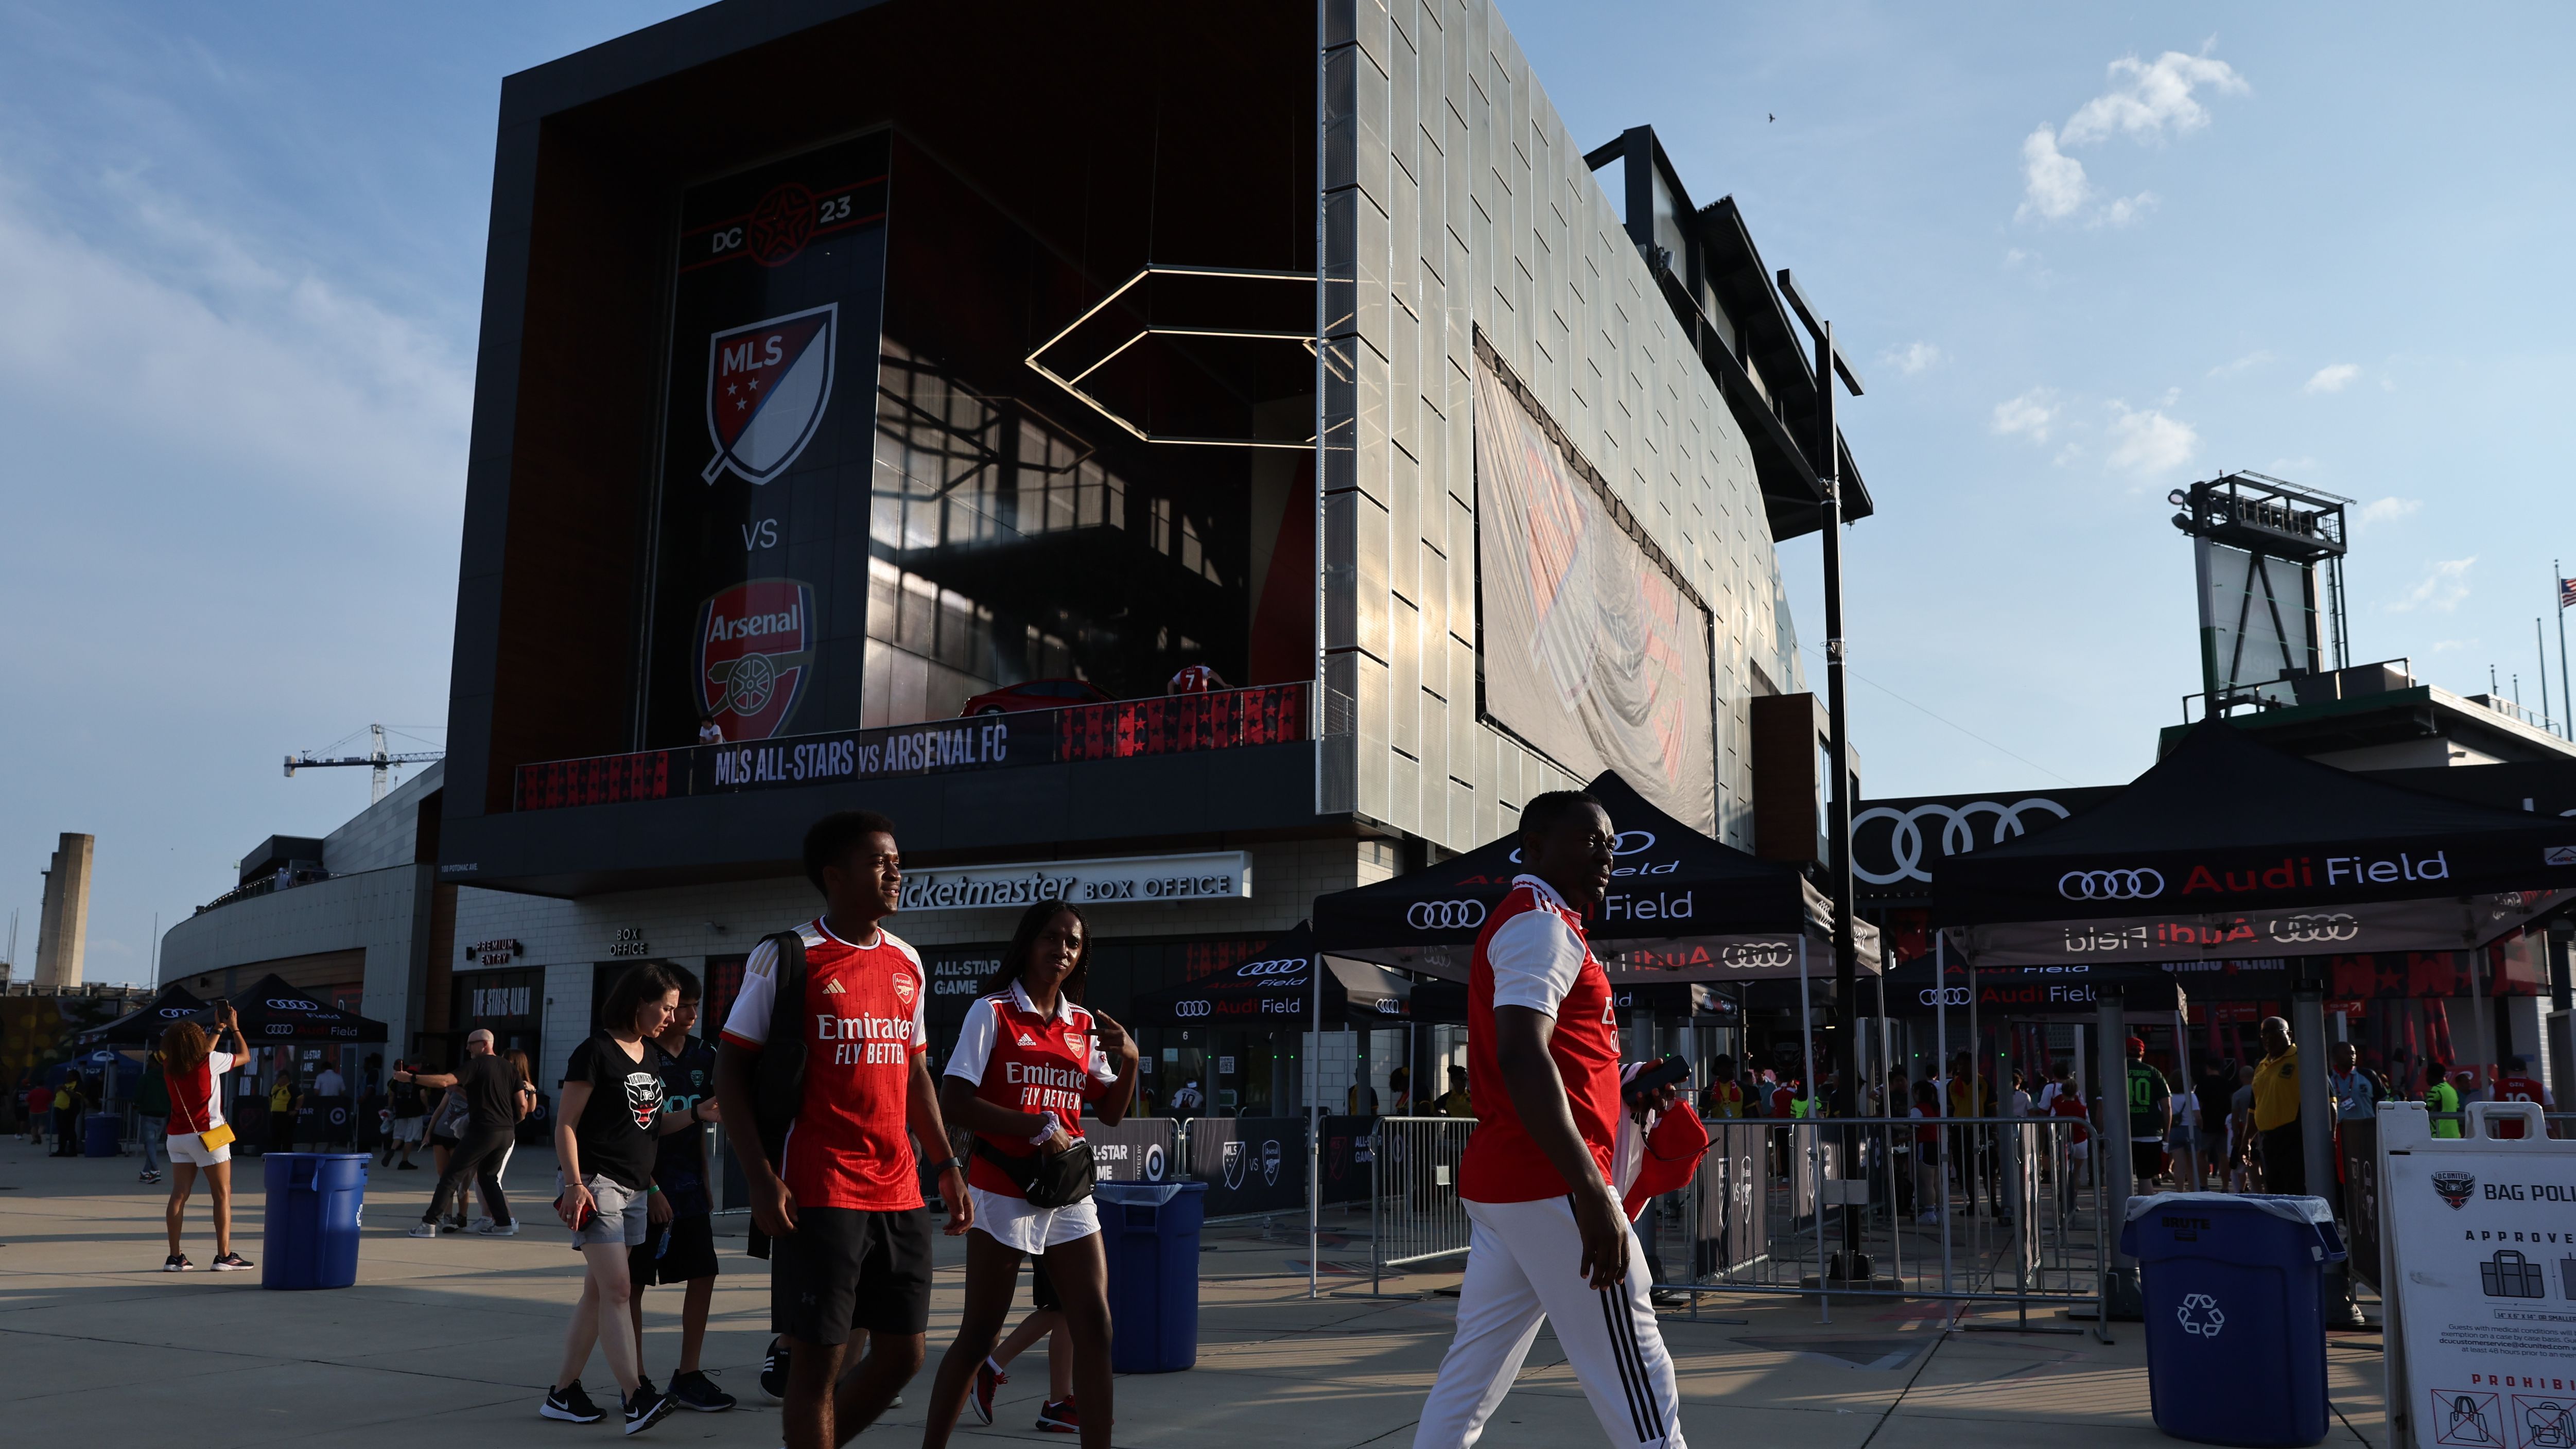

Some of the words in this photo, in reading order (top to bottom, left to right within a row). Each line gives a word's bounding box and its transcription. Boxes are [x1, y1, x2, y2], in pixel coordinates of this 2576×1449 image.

[712, 228, 741, 253] DC
[820, 196, 850, 223] 23
[723, 335, 782, 376] MLS
[742, 519, 777, 551] VS
[709, 604, 797, 642] Arsenal
[1186, 674, 1194, 690] 7
[715, 748, 751, 785] MLS
[755, 739, 854, 782] ALL-STARS
[883, 727, 976, 772] ARSENAL
[981, 723, 1007, 762] FC
[2181, 857, 2313, 895] Audi
[2327, 850, 2450, 885] Field
[898, 872, 1074, 908] icketmaster
[1084, 880, 1132, 900] BOX
[1143, 876, 1230, 897] OFFICE
[1605, 891, 1693, 921] Field
[617, 929, 641, 940] BOX
[477, 939, 516, 952] PREMIUM
[610, 943, 647, 956] OFFICE
[481, 954, 509, 965] ENTRY
[935, 959, 1001, 975] ALL-STAR
[934, 980, 978, 994] GAME
[1257, 977, 1308, 988] Field
[1980, 985, 2043, 1003] Audi
[1215, 1000, 1259, 1015] Audi
[1262, 998, 1300, 1014] Field
[306, 1012, 341, 1020] Field
[330, 1026, 358, 1037] Field
[816, 1011, 914, 1040] Emirates
[1182, 1031, 1188, 1040] 6
[303, 1050, 321, 1060] LL-STAR
[835, 1043, 862, 1065] FLY
[300, 1062, 314, 1072] AME
[1005, 1062, 1087, 1091] Emirates
[1020, 1087, 1041, 1105] FLY
[1042, 1089, 1081, 1111] BETTER
[1093, 1145, 1128, 1160] L-STAR
[1225, 1146, 1237, 1156] MLS
[1096, 1165, 1112, 1181] ME
[1249, 1158, 1259, 1172] VS
[1733, 1182, 1740, 1202] VS
[2484, 1184, 2525, 1201] BAG
[2162, 1217, 2211, 1230] BRUTE
[2439, 1338, 2570, 1350] dcucustomerservice@dcunited.com
